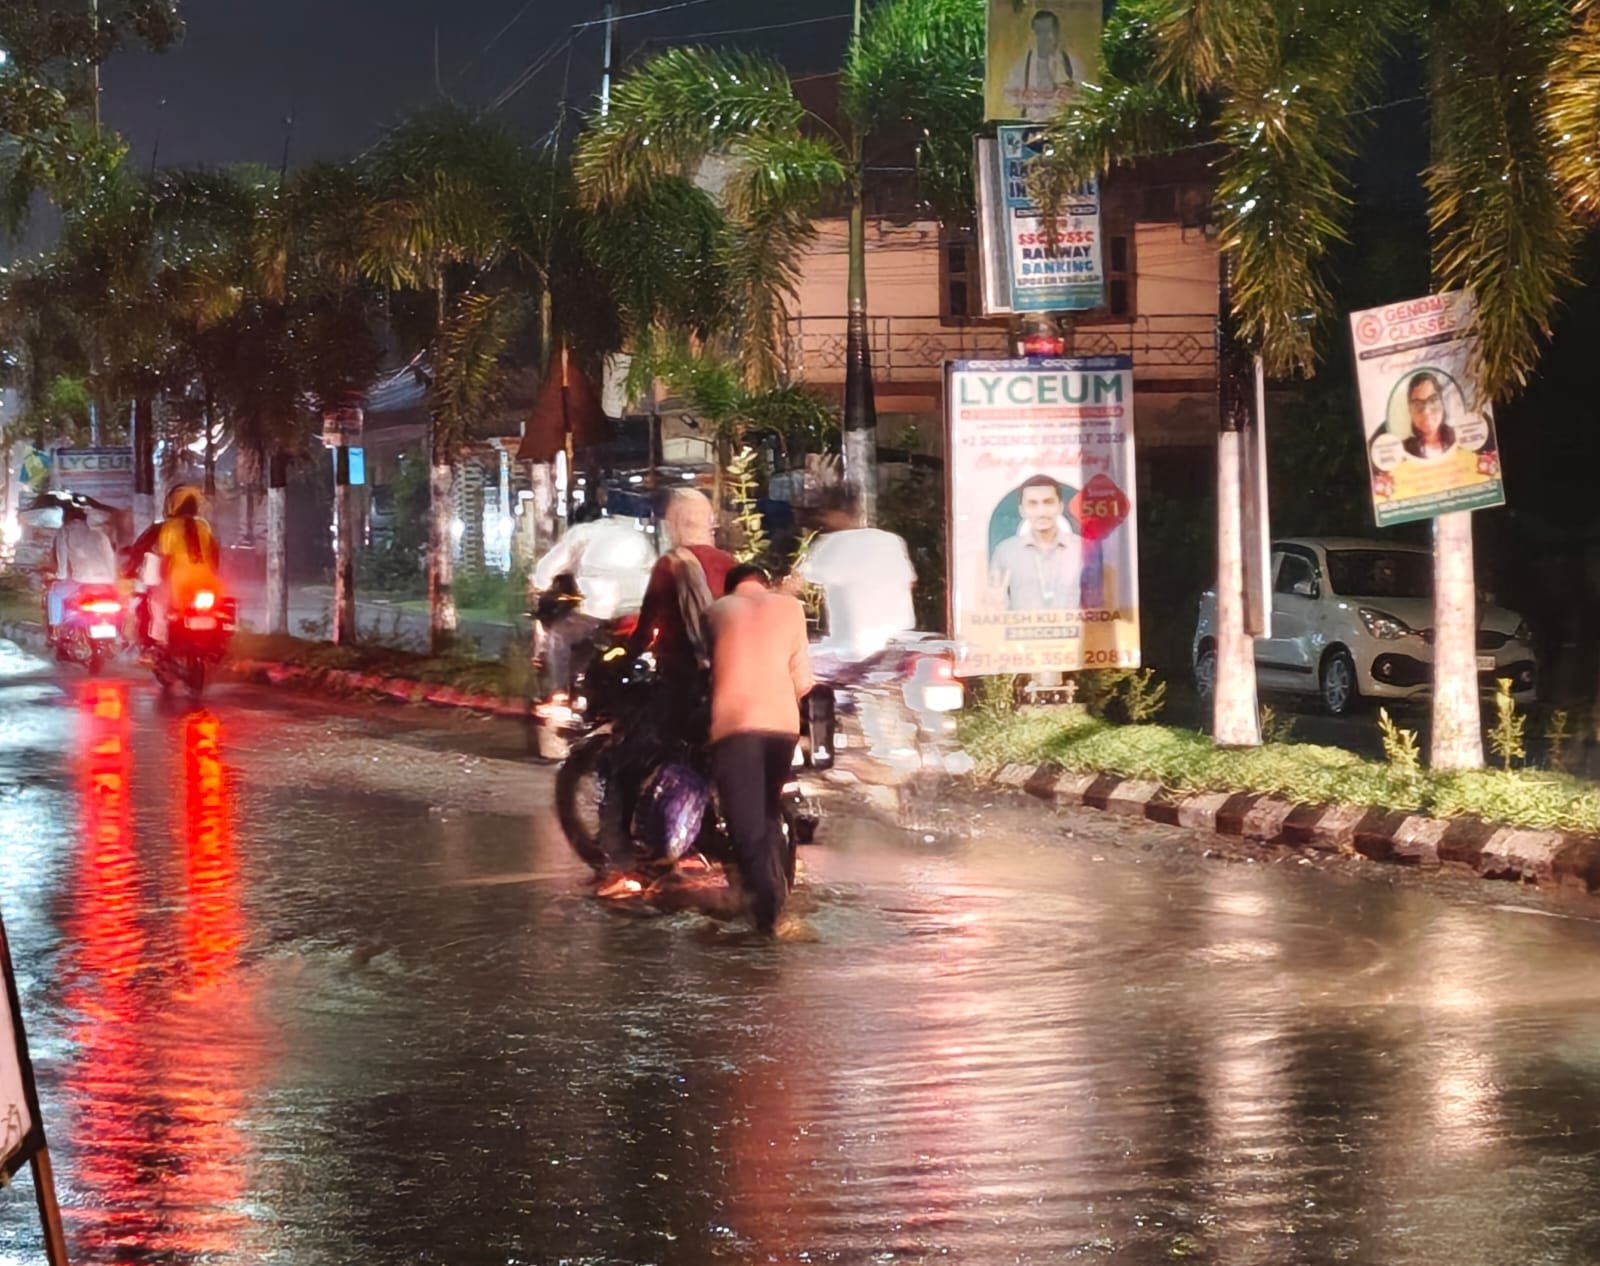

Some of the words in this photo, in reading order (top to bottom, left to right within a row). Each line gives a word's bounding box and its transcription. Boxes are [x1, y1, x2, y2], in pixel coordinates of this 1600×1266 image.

[1022, 261, 1094, 274] BANKING
[1389, 313, 1457, 341] CLASSES
[960, 374, 1123, 404] LYCEUM
[1082, 500, 1120, 518] 561
